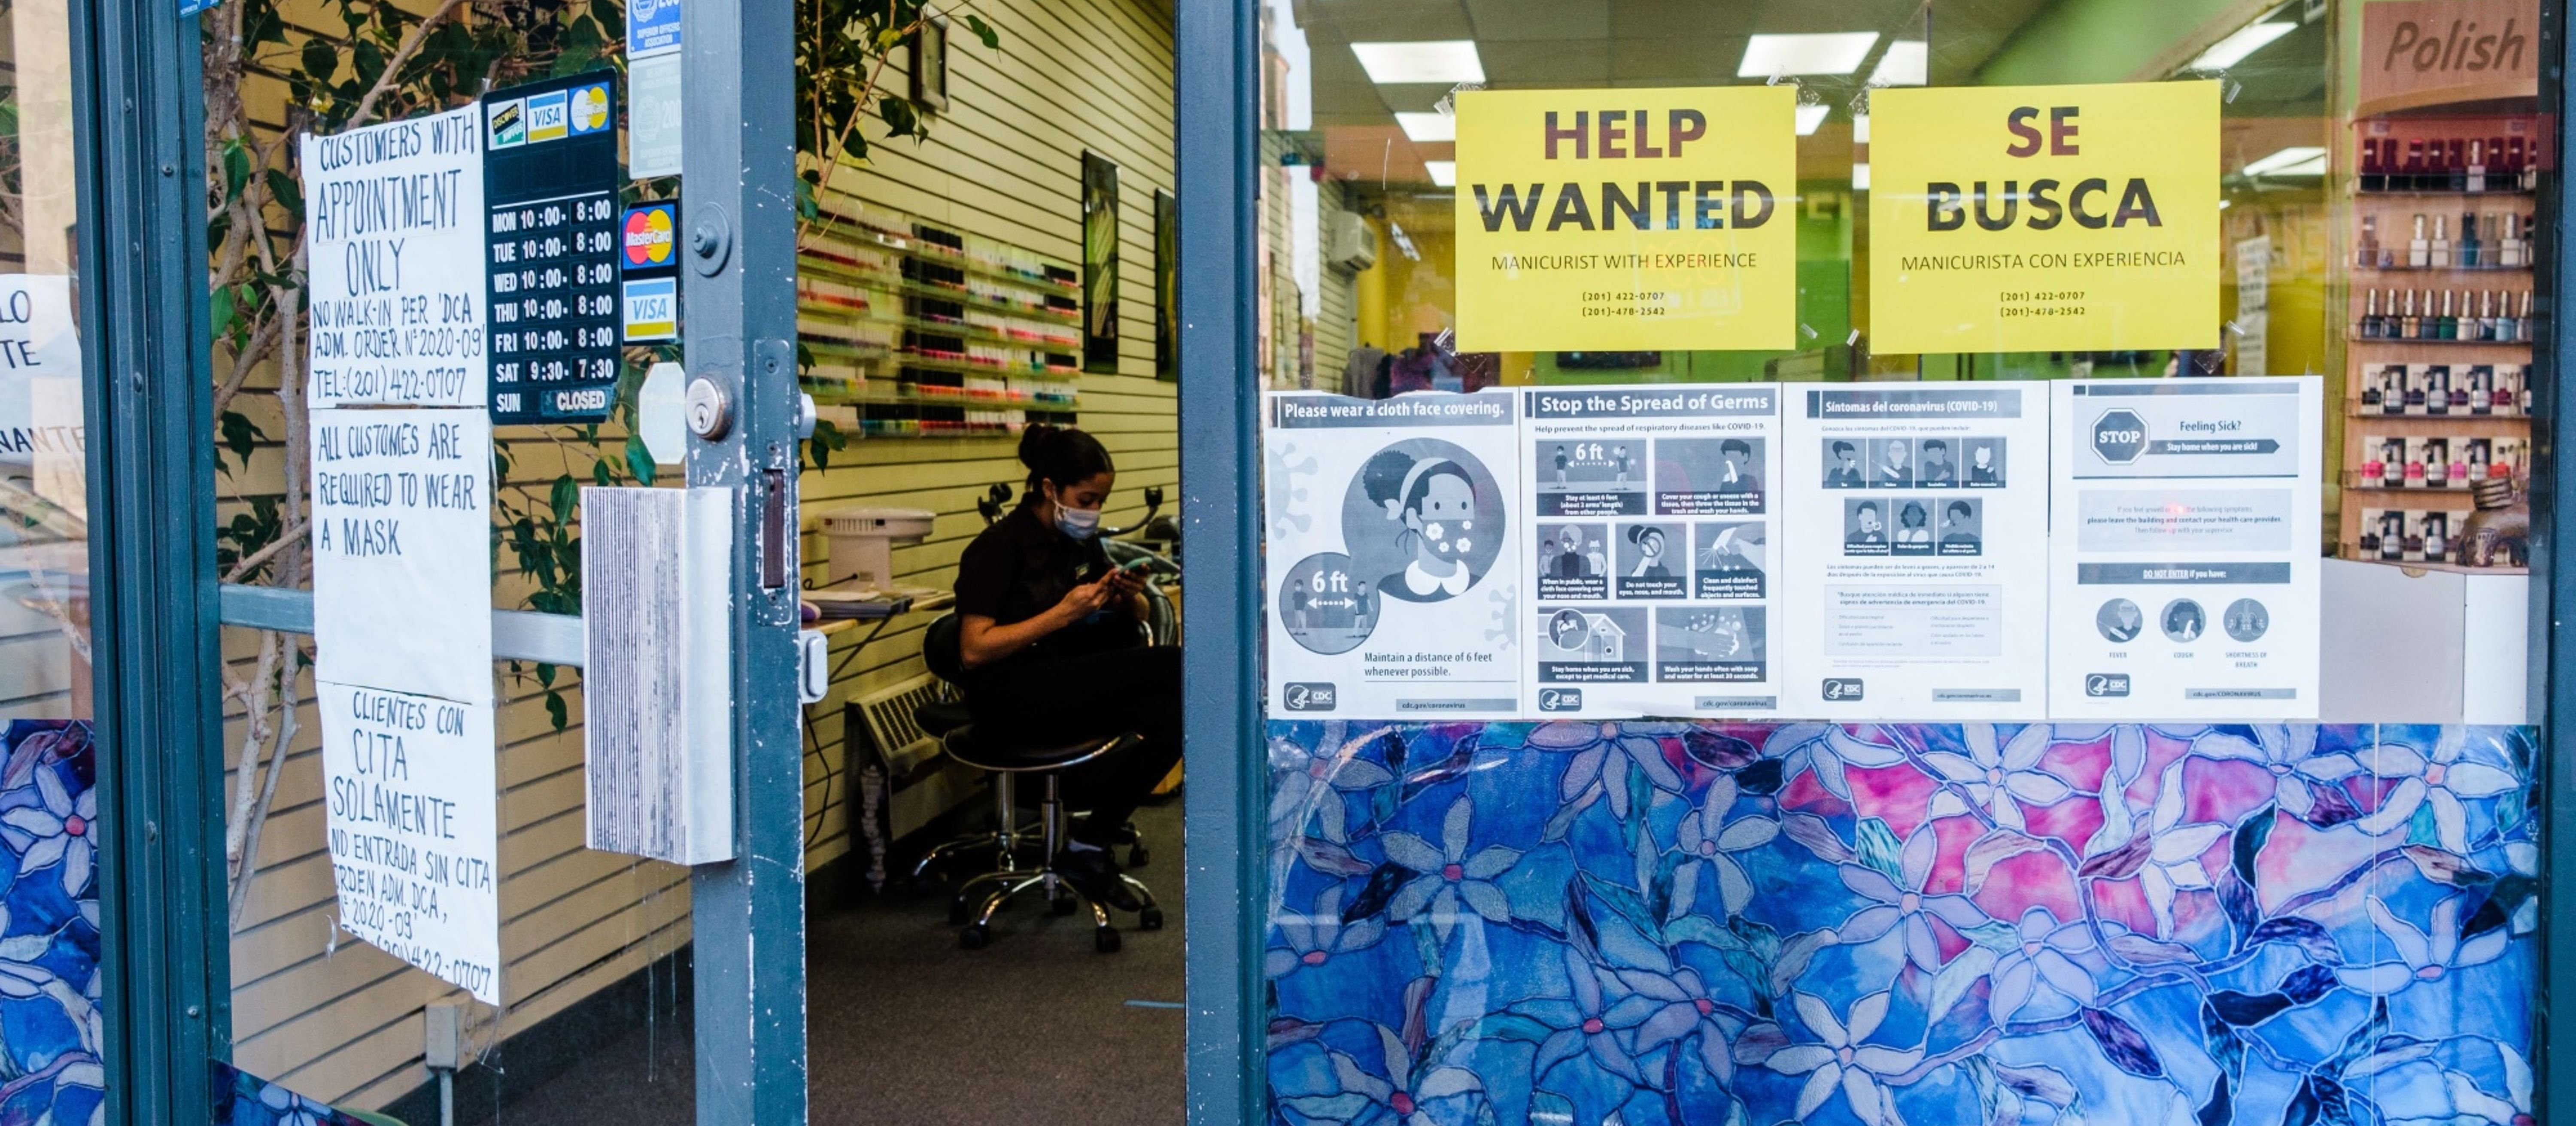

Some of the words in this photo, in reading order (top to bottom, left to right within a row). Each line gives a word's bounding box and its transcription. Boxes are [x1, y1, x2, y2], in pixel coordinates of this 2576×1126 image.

[2384, 18, 2524, 72] Polish
[534, 107, 561, 127] VISA
[320, 122, 422, 172] CUSTOMERS
[431, 112, 474, 155] WITH
[1545, 109, 1707, 159] HELP
[2006, 106, 2080, 158] SE
[316, 169, 462, 243] APPOINTMENT
[1472, 180, 1775, 232] WANTED
[1927, 177, 2163, 232] BUSCA
[493, 212, 516, 233] MON
[626, 229, 671, 246] MasterCard
[493, 242, 516, 263] TUE
[1492, 255, 1598, 270] MANICURIST
[1604, 254, 1649, 270] WITH
[1656, 253, 1757, 269] EXPERIENCE
[1902, 253, 2023, 271] MANICURISTA
[2029, 253, 2067, 269] CON
[2074, 251, 2186, 268] EXPERIENCIA
[346, 238, 405, 297] ONLY
[494, 273, 517, 293] WED
[1616, 292, 1665, 300] 422-0707
[2035, 291, 2085, 300] 422-0707
[313, 300, 330, 329] NO
[401, 294, 428, 326] PER
[494, 303, 518, 322] THU
[632, 298, 667, 320] VISA
[315, 331, 348, 359] ADM.
[354, 328, 401, 359] ORDER
[495, 333, 518, 353] FRI
[495, 363, 519, 382] SAT
[497, 393, 520, 412] SUN
[557, 390, 605, 410] CLOSED
[1285, 403, 1327, 417] Please
[1331, 405, 1363, 417] wear
[1366, 406, 1373, 416] a
[1377, 401, 1410, 416] cloth
[1413, 401, 1440, 416] face
[1444, 401, 1504, 419] covering.
[1541, 397, 1582, 414] Stop
[1586, 396, 1616, 411] the
[1621, 395, 1683, 414] Spread
[1688, 394, 1707, 410] of
[1710, 395, 1768, 410] Germs
[1826, 401, 1870, 413] Síntomas
[1872, 402, 1887, 412] del
[1889, 402, 1944, 412] coronavirus
[1947, 401, 1997, 413] (COVID-19)
[1535, 425, 1552, 434] Help
[1635, 424, 1677, 433] respiratory
[2099, 430, 2141, 443] STOP
[2180, 421, 2216, 434] Feeling
[2218, 420, 2242, 431] Sick?
[318, 426, 342, 462] ALL
[348, 423, 419, 458] CUSTOMES
[428, 423, 462, 460] ARE
[1576, 444, 1586, 460] 6
[1589, 443, 1603, 459] ft
[2167, 443, 2181, 452] Stay
[2220, 444, 2231, 452] you
[319, 472, 392, 509] REQUIRED
[398, 473, 418, 507] TO
[425, 473, 477, 510] WEAR
[322, 518, 331, 551] A
[343, 518, 401, 558] MASK
[1312, 570, 1326, 593] 6
[1330, 570, 1348, 592] ft
[2143, 570, 2152, 578] DO
[2169, 570, 2189, 578] ENTER
[2190, 570, 2195, 578] if
[2196, 571, 2207, 579] you
[1364, 653, 1405, 662] Maintain
[1415, 652, 1452, 662] distance
[1455, 652, 1464, 662] of
[1466, 653, 1472, 662] 6
[1474, 652, 1492, 662] feet
[1364, 667, 1409, 676] whenever
[1411, 666, 1450, 678] possible.
[1313, 691, 1332, 701] CDC
[353, 691, 427, 730] CLIENTES
[436, 705, 464, 737] CON
[353, 728, 408, 782] CITA
[333, 775, 456, 839] SOLAMENTE
[354, 834, 417, 875] ENTRADA
[425, 850, 449, 887] SIN
[456, 856, 491, 894] CITA
[380, 873, 407, 907] ADM.
